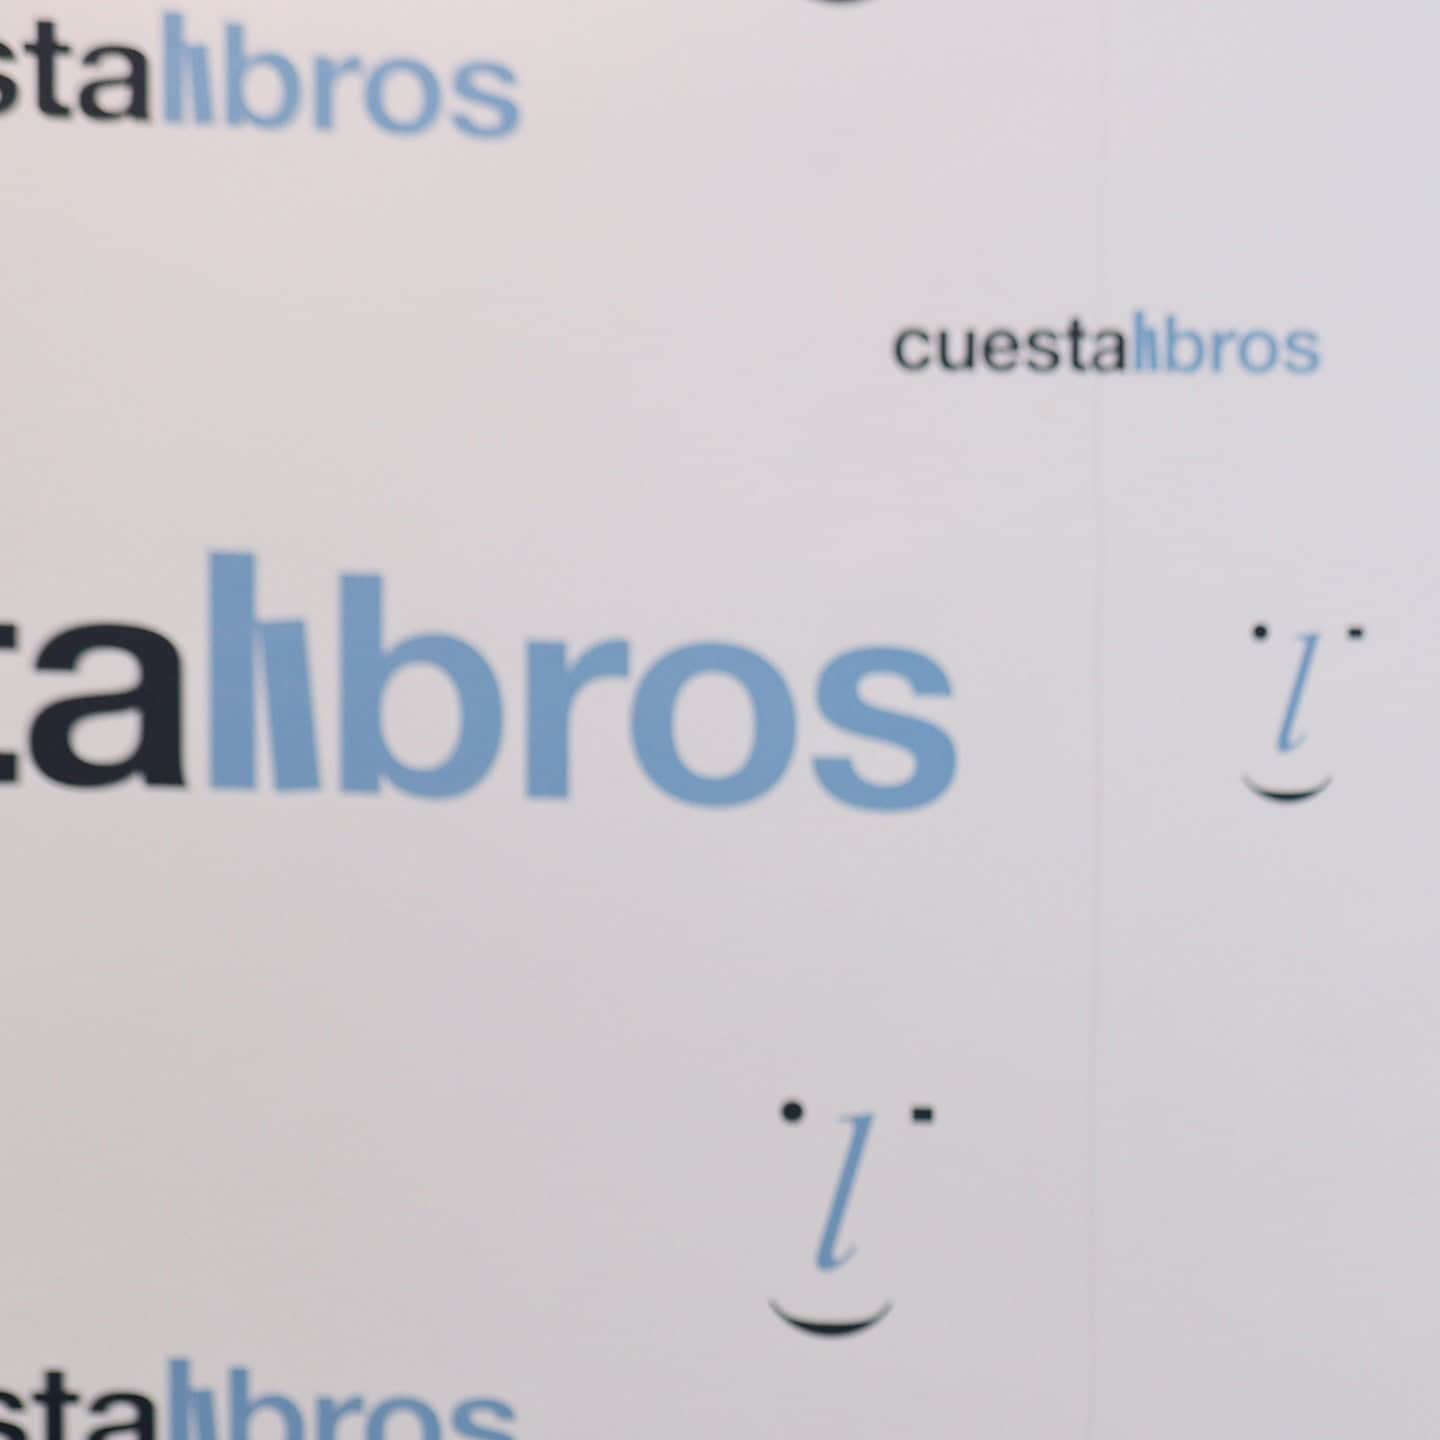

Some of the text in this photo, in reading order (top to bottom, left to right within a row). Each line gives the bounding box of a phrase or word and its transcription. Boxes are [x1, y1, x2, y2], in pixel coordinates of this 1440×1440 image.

[0, 12, 520, 139] talibros
[892, 310, 1321, 374] cuestalibros
[0, 551, 957, 812] alibros
